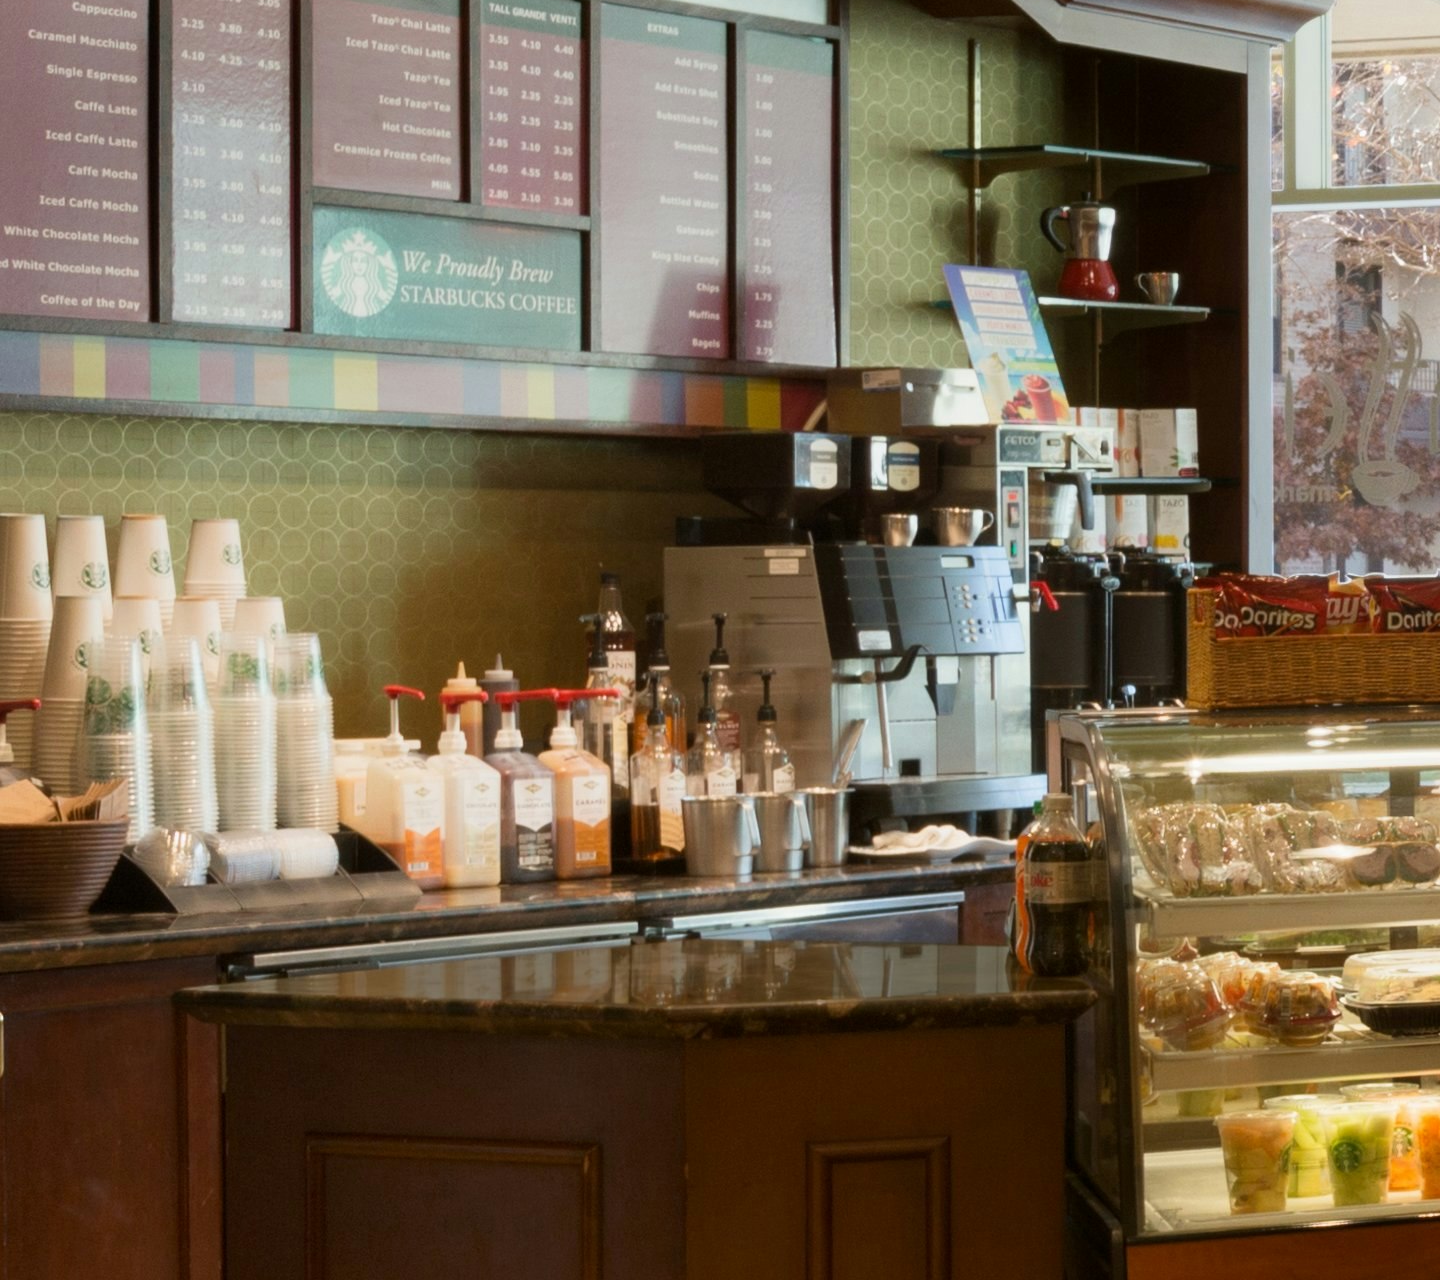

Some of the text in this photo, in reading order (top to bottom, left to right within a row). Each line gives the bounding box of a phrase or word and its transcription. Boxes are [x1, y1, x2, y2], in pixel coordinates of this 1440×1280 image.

[72, 2, 138, 19] Cappuccino
[489, 3, 577, 26] TALL GRANDE VENTI
[181, 18, 204, 30] 3.25
[257, 28, 281, 39] 4.10
[401, 19, 451, 34] Chai Latte
[647, 23, 679, 36] EXTRAS
[28, 29, 138, 52] Caramel Macchiato
[345, 37, 451, 60] Iced Chai Latte
[521, 38, 541, 50] 4.10
[554, 44, 574, 55] 4.40
[181, 50, 205, 62] 4.10
[674, 57, 691, 68] Add
[46, 64, 138, 84] Single Espresso
[433, 74, 451, 86] Tea
[521, 64, 541, 75] 4.10
[554, 69, 574, 81] 4.40
[181, 81, 205, 93] 2.10
[655, 82, 672, 93] Add
[74, 101, 138, 116] Caffe Latte
[379, 95, 451, 112] Iced Tea
[382, 121, 451, 138] Hot Chocolate
[45, 130, 138, 148] Iced Caffe Latte
[334, 143, 452, 165] Creamice Frozen Coffee
[68, 165, 138, 181] Caffe Mocha
[39, 195, 139, 213] Iced Caffe Mocha
[4, 225, 139, 245] White Chocolate Mocha
[12, 259, 140, 277] White Chocolate Mocha
[402, 250, 554, 286] We Proudly Brew
[696, 283, 720, 294] Chips
[755, 291, 772, 302] 1.75
[40, 294, 141, 312] Coffee of the Day
[400, 285, 577, 315] STARBUCKS COFFEE
[688, 309, 720, 321] Muffins
[692, 337, 720, 350] Bagels
[1004, 434, 1037, 446] FETCO
[1162, 498, 1185, 508] TAZO
[1241, 606, 1316, 629] Doritos
[575, 798, 607, 807] CARAMEL
